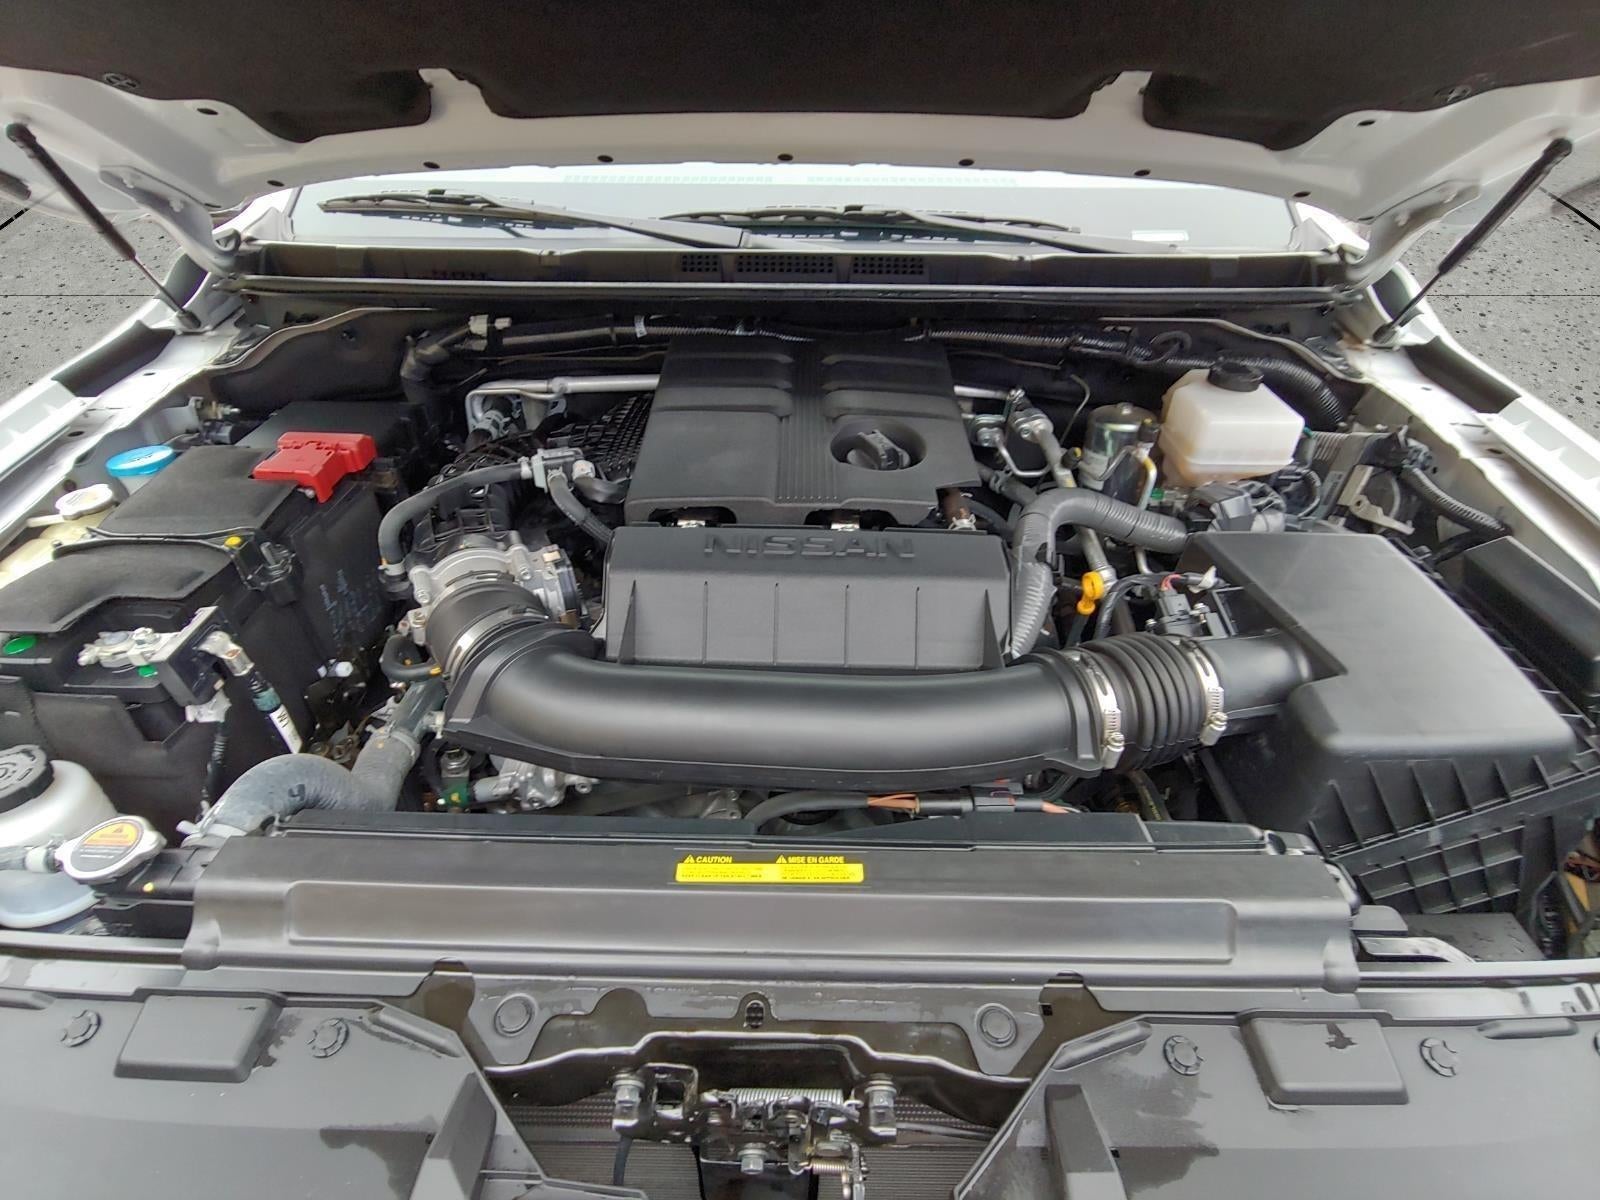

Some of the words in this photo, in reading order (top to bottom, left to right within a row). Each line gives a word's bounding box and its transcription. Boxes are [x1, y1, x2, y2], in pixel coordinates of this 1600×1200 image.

[704, 534, 916, 559] NISSAN
[696, 855, 733, 864] CAUTION
[787, 855, 806, 864] MISE
[806, 855, 818, 864] EN
[818, 855, 845, 864] GARDE
